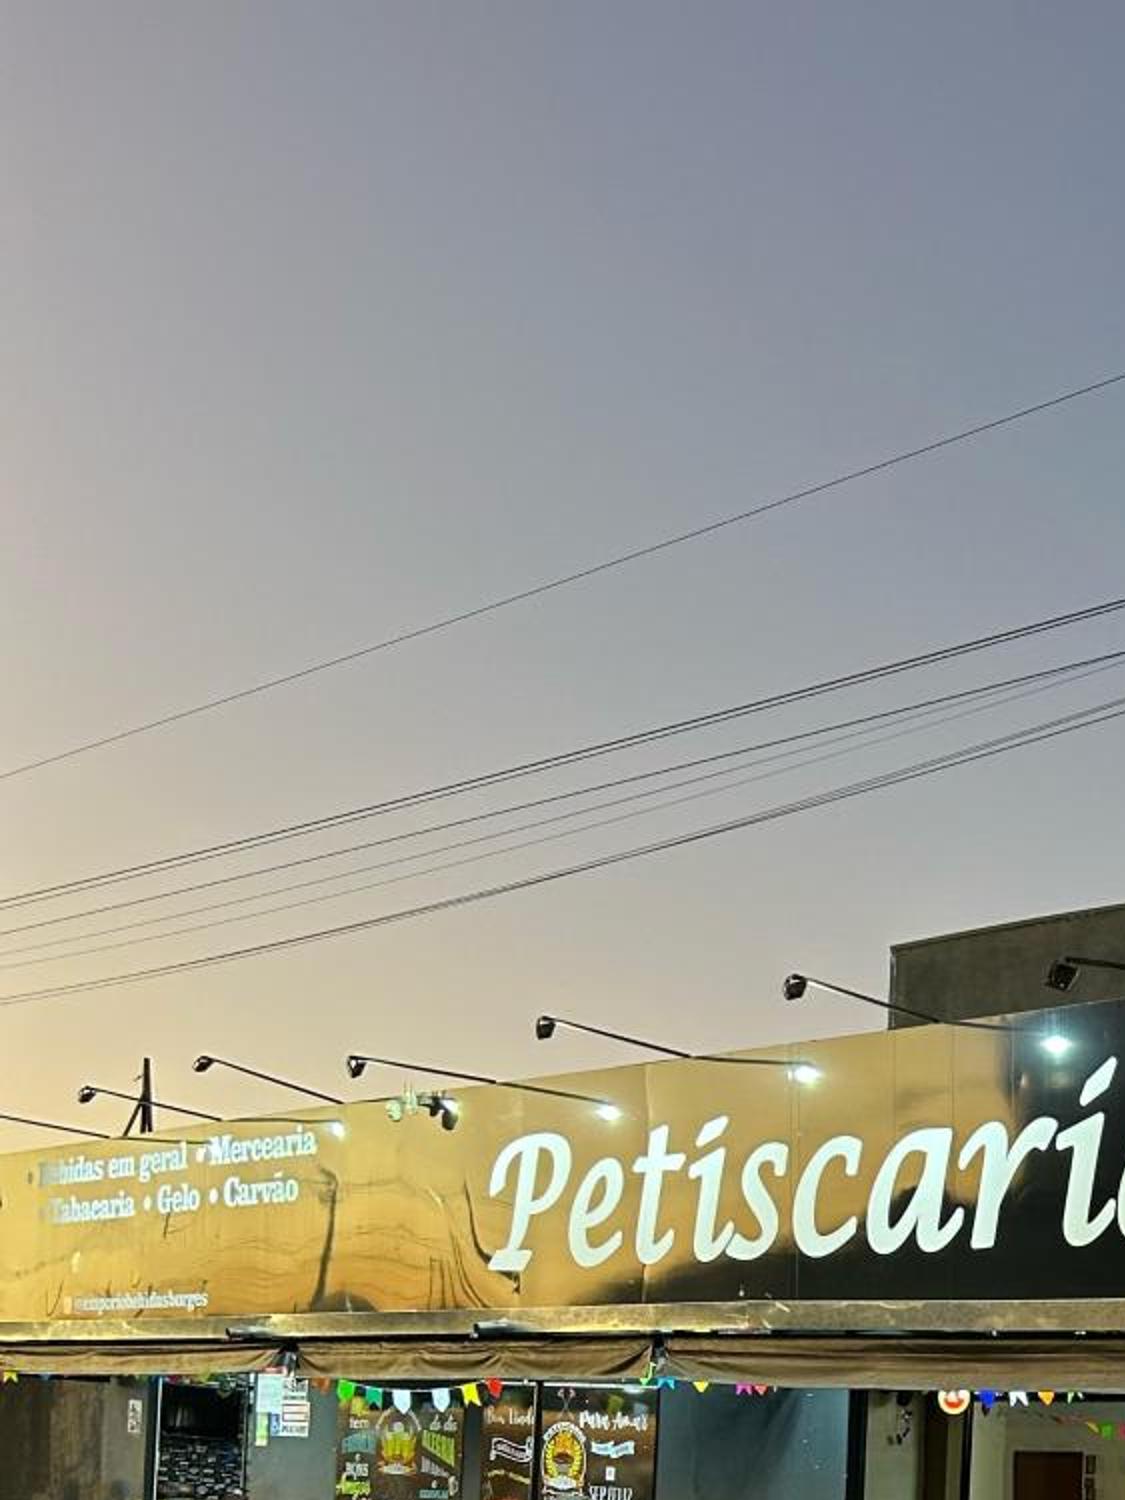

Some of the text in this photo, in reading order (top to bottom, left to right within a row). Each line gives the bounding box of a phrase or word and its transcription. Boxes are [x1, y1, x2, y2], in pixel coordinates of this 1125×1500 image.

[107, 1157, 136, 1180] em
[138, 1142, 189, 1183] geral
[207, 1125, 318, 1166] Mercearia
[156, 1181, 200, 1214] Gelo
[223, 1171, 299, 1208] Carvão
